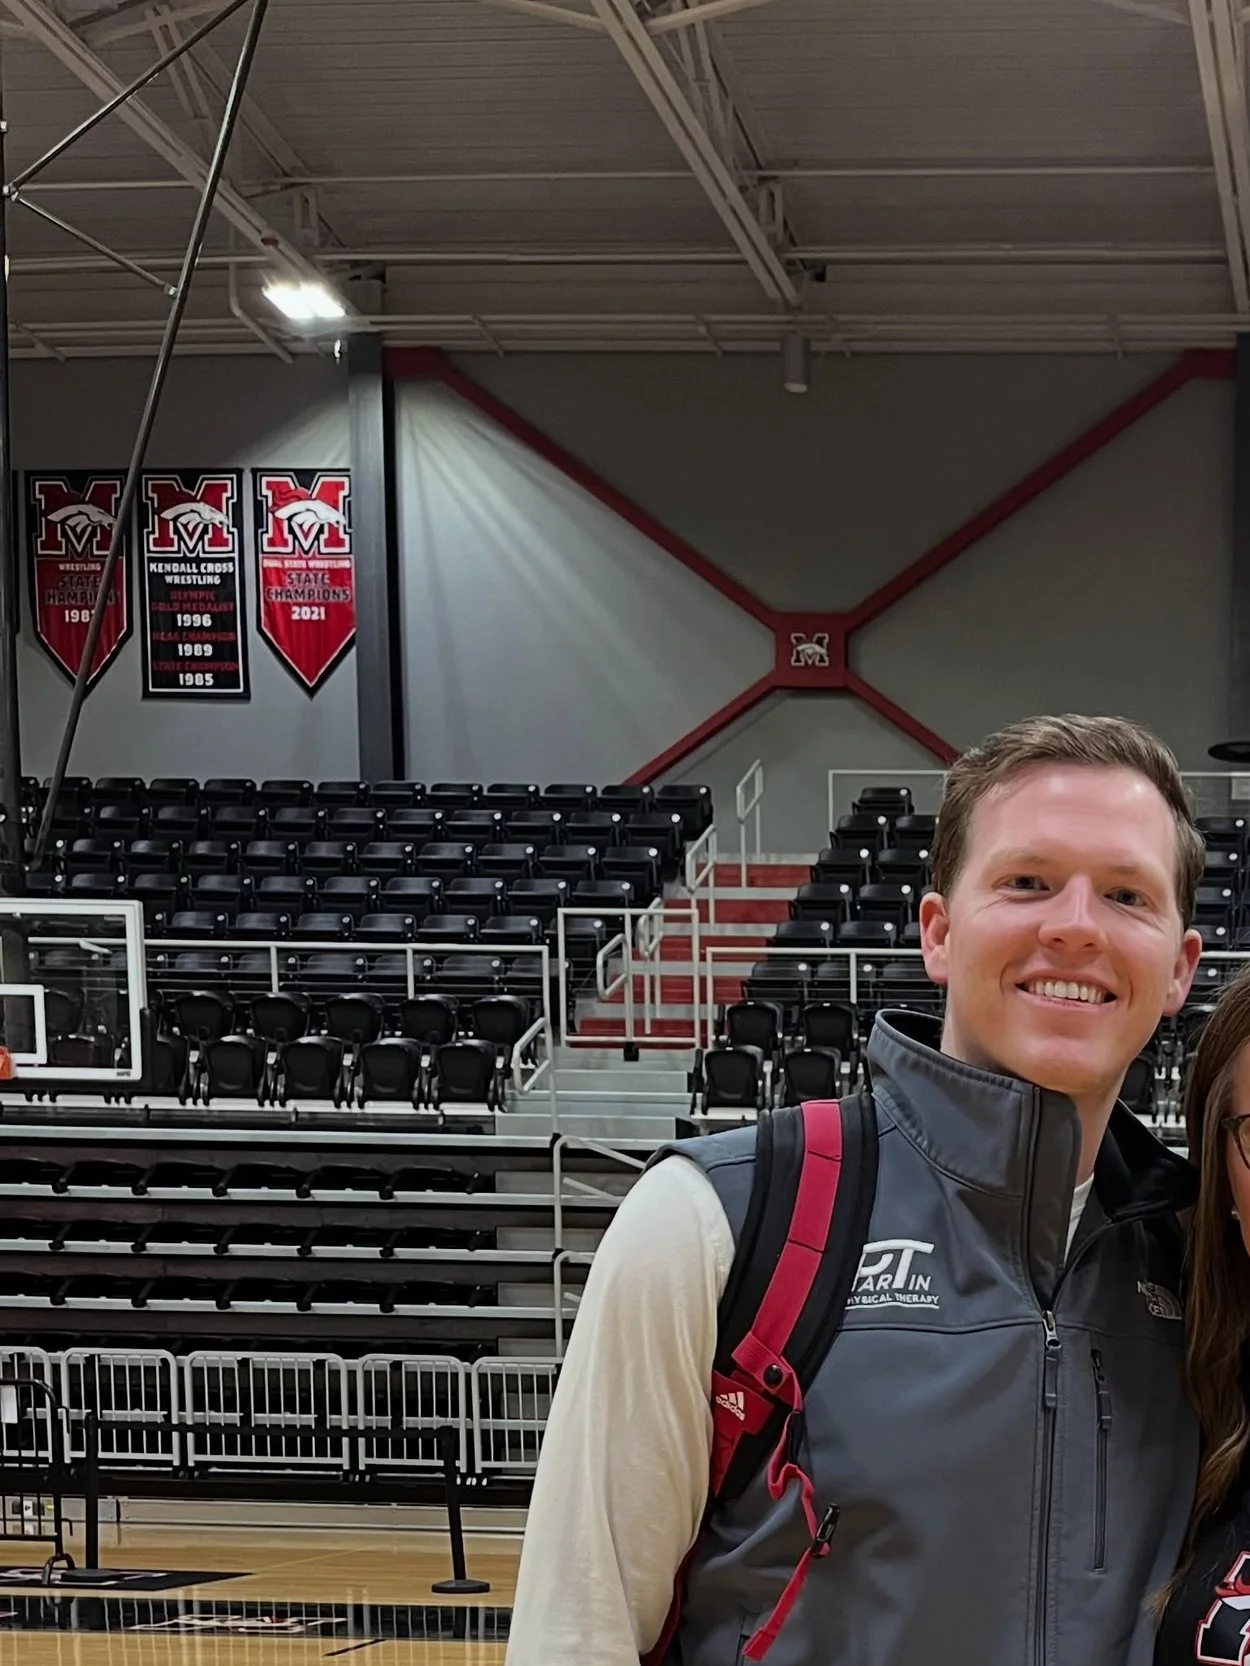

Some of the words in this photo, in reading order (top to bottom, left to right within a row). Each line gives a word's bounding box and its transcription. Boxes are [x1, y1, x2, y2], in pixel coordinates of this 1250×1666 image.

[149, 562, 199, 573] KENDALL
[200, 562, 234, 573] CROSS
[165, 575, 221, 584] WRESTLING
[287, 571, 330, 586] STATE
[265, 587, 351, 601] CHAMPIONS
[291, 606, 326, 620] 2021
[177, 613, 212, 627] 1996
[178, 643, 213, 656] 1989
[179, 673, 214, 686] 1985
[846, 1293, 893, 1305] HYSICAL
[894, 1292, 940, 1304] THERAPY
